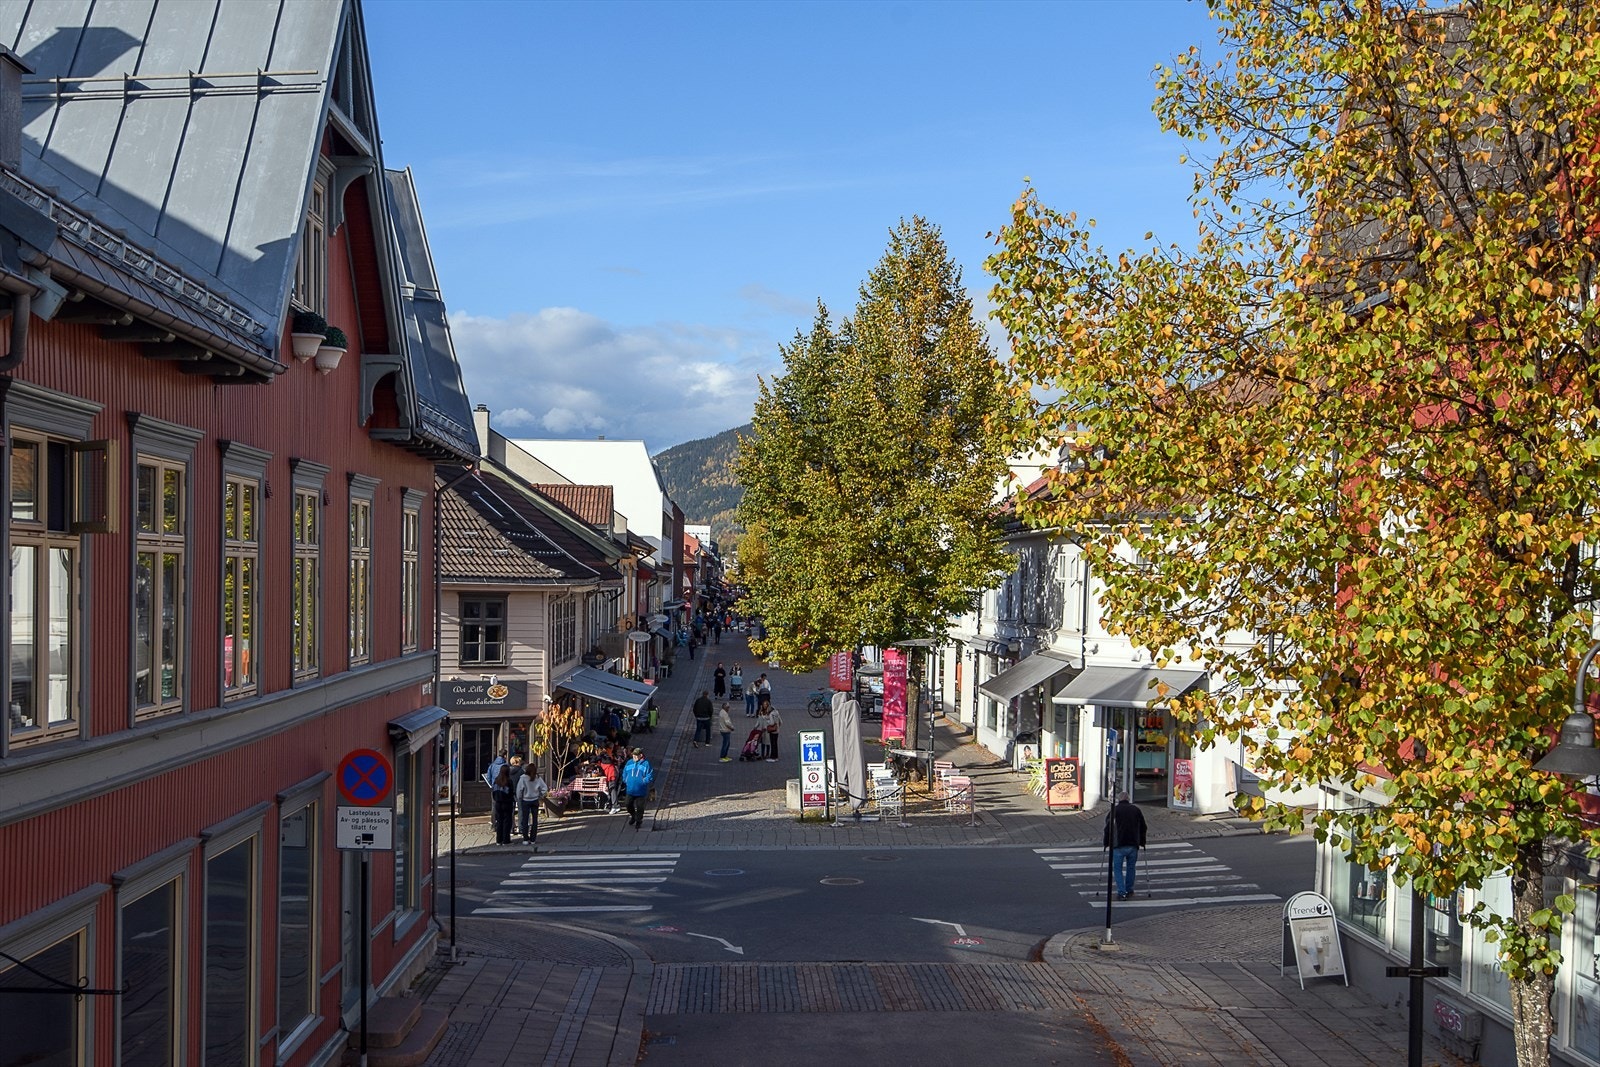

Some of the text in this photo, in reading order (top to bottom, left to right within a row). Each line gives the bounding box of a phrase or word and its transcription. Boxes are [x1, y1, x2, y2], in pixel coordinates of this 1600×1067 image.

[452, 685, 484, 693] Det Lille
[1050, 764, 1076, 773] LOADED
[1053, 771, 1073, 780] FRIES
[361, 816, 390, 825] pålessing
